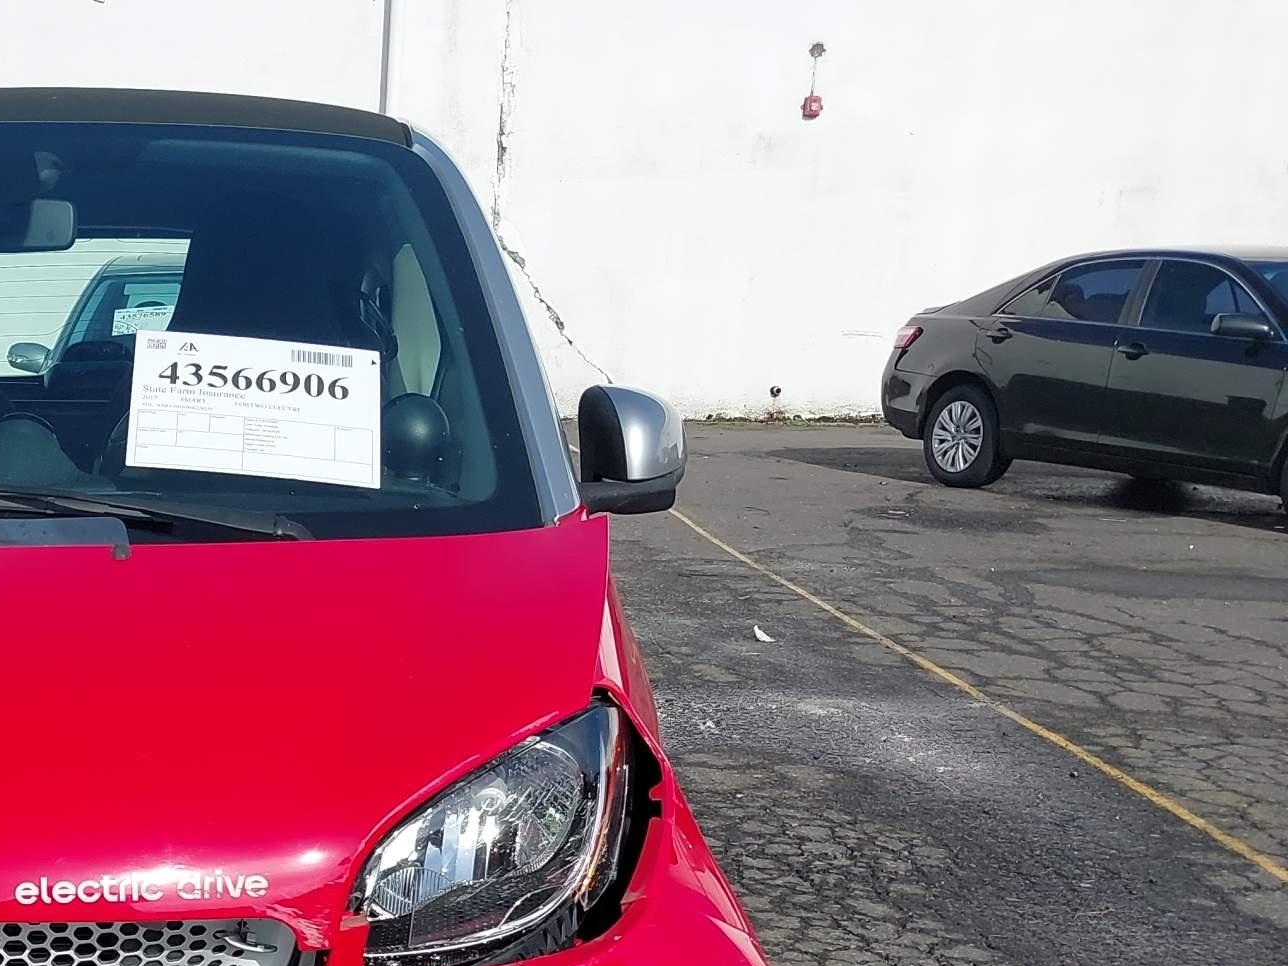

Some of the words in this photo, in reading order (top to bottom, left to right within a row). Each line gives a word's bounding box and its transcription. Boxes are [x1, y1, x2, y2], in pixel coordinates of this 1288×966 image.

[142, 384, 168, 393] State
[170, 386, 196, 396] Farm
[199, 388, 246, 400] Insurance
[158, 361, 350, 400] 43566906
[14, 872, 164, 905] electric
[176, 869, 269, 899] drive
